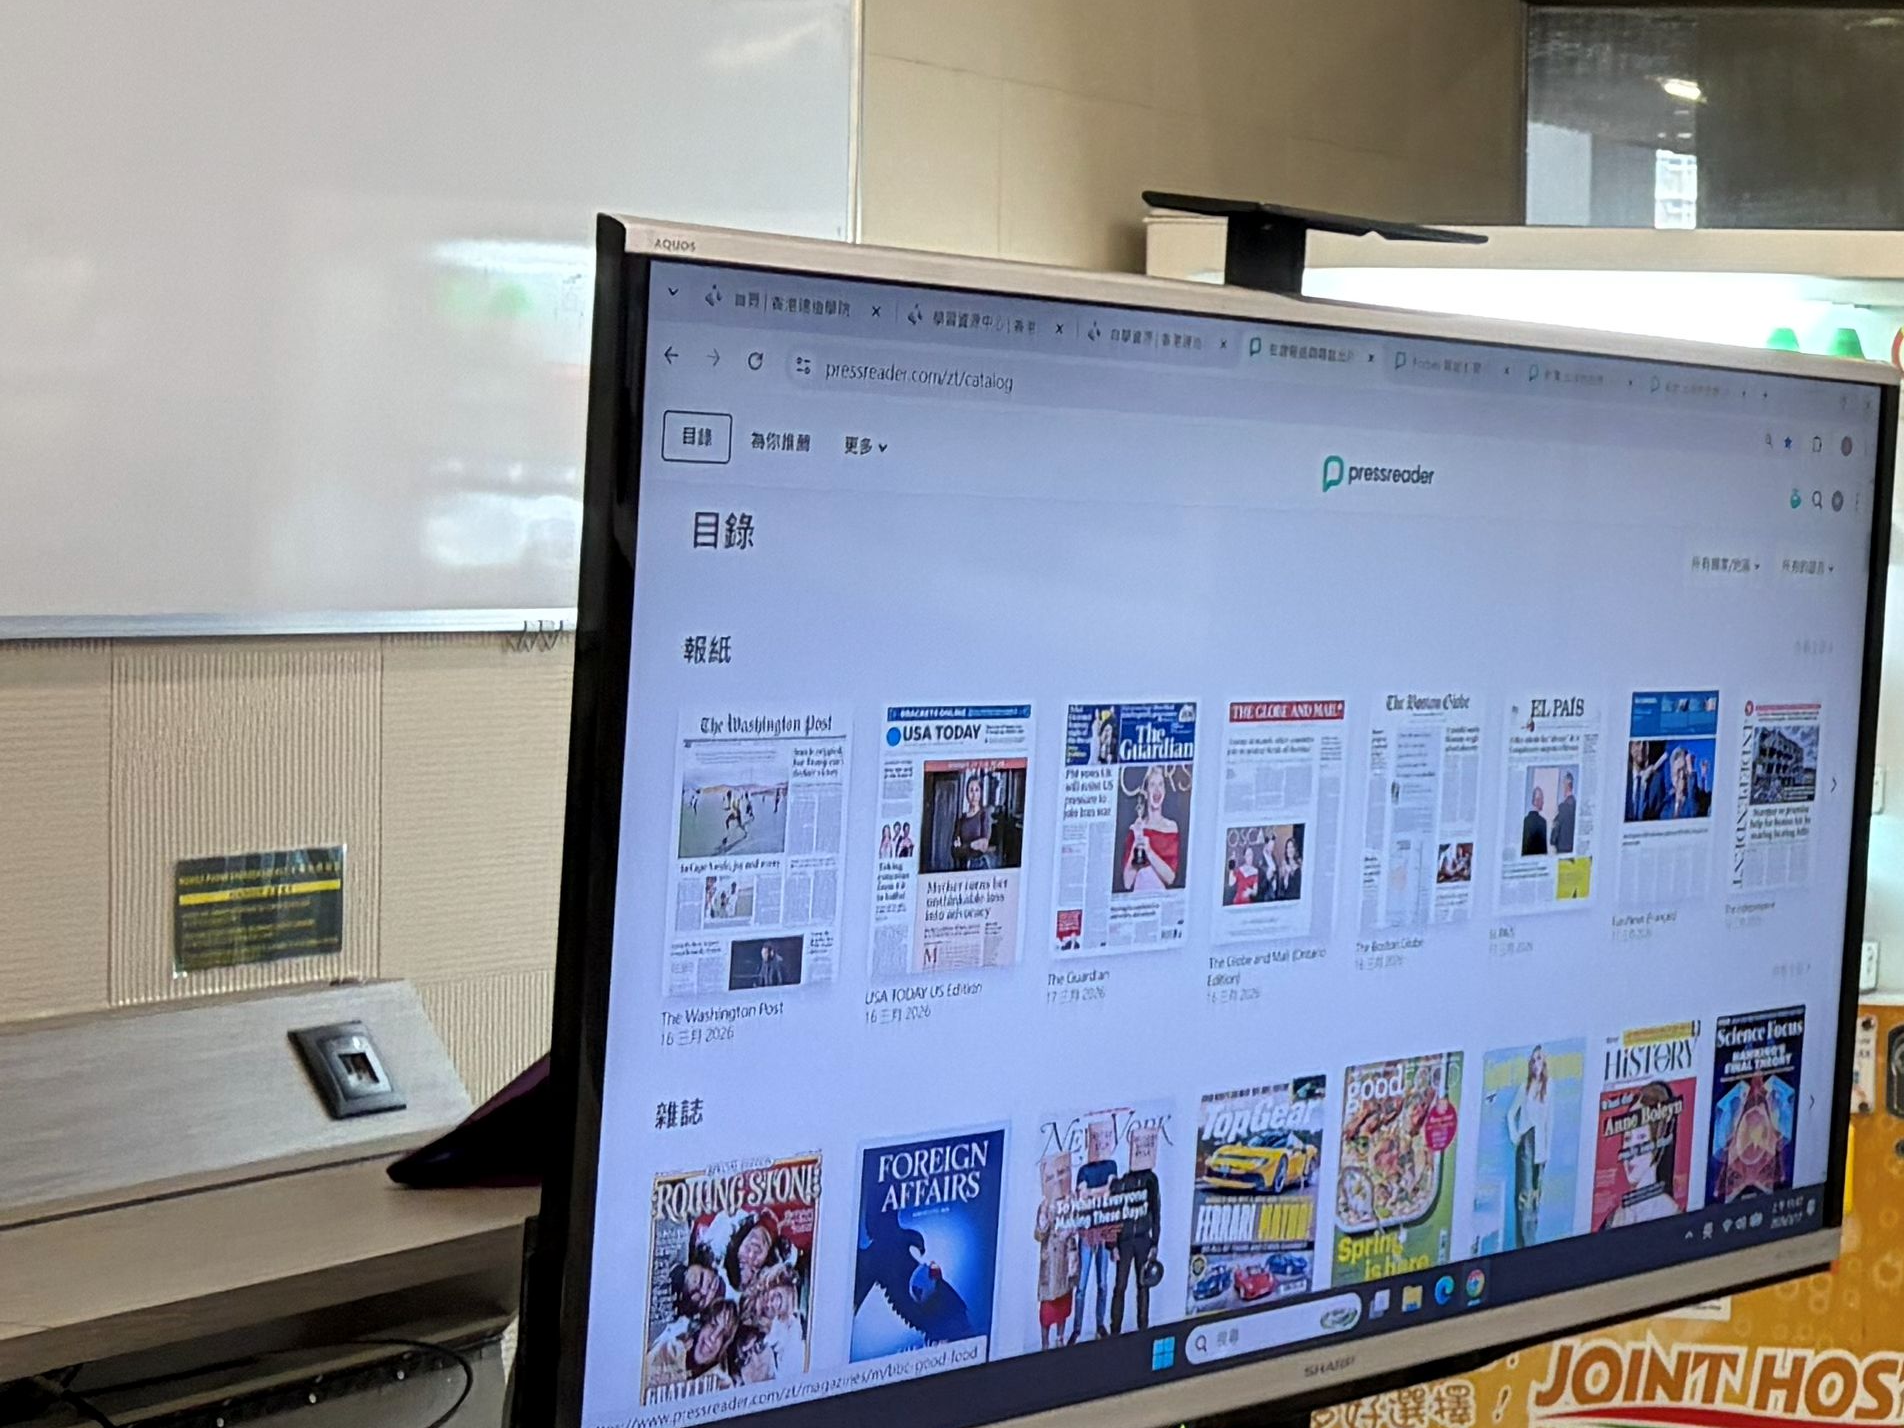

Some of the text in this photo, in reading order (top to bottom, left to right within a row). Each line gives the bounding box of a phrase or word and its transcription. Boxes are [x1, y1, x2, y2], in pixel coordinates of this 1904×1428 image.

[845, 436, 873, 455] 更多
[1348, 464, 1434, 485] pressreader
[693, 512, 755, 551] 目錄
[683, 636, 732, 666] 報紙
[1233, 704, 1254, 720] THE
[1530, 695, 1585, 718] EL PAÍS
[727, 713, 801, 737] Washington
[805, 713, 832, 736] Post
[903, 724, 982, 742] USA TODAY
[1135, 722, 1166, 743] The
[1119, 738, 1194, 761] Guardian
[865, 990, 889, 1006] USA
[661, 1000, 784, 1027] The Washington Post
[1716, 1021, 1767, 1048] Science
[1347, 1063, 1404, 1115] good
[655, 1098, 704, 1130] 雜誌
[878, 1140, 989, 1183] FOREIGN
[881, 1171, 981, 1213] AFFAIRS
[1534, 1342, 1745, 1407] JOINT
